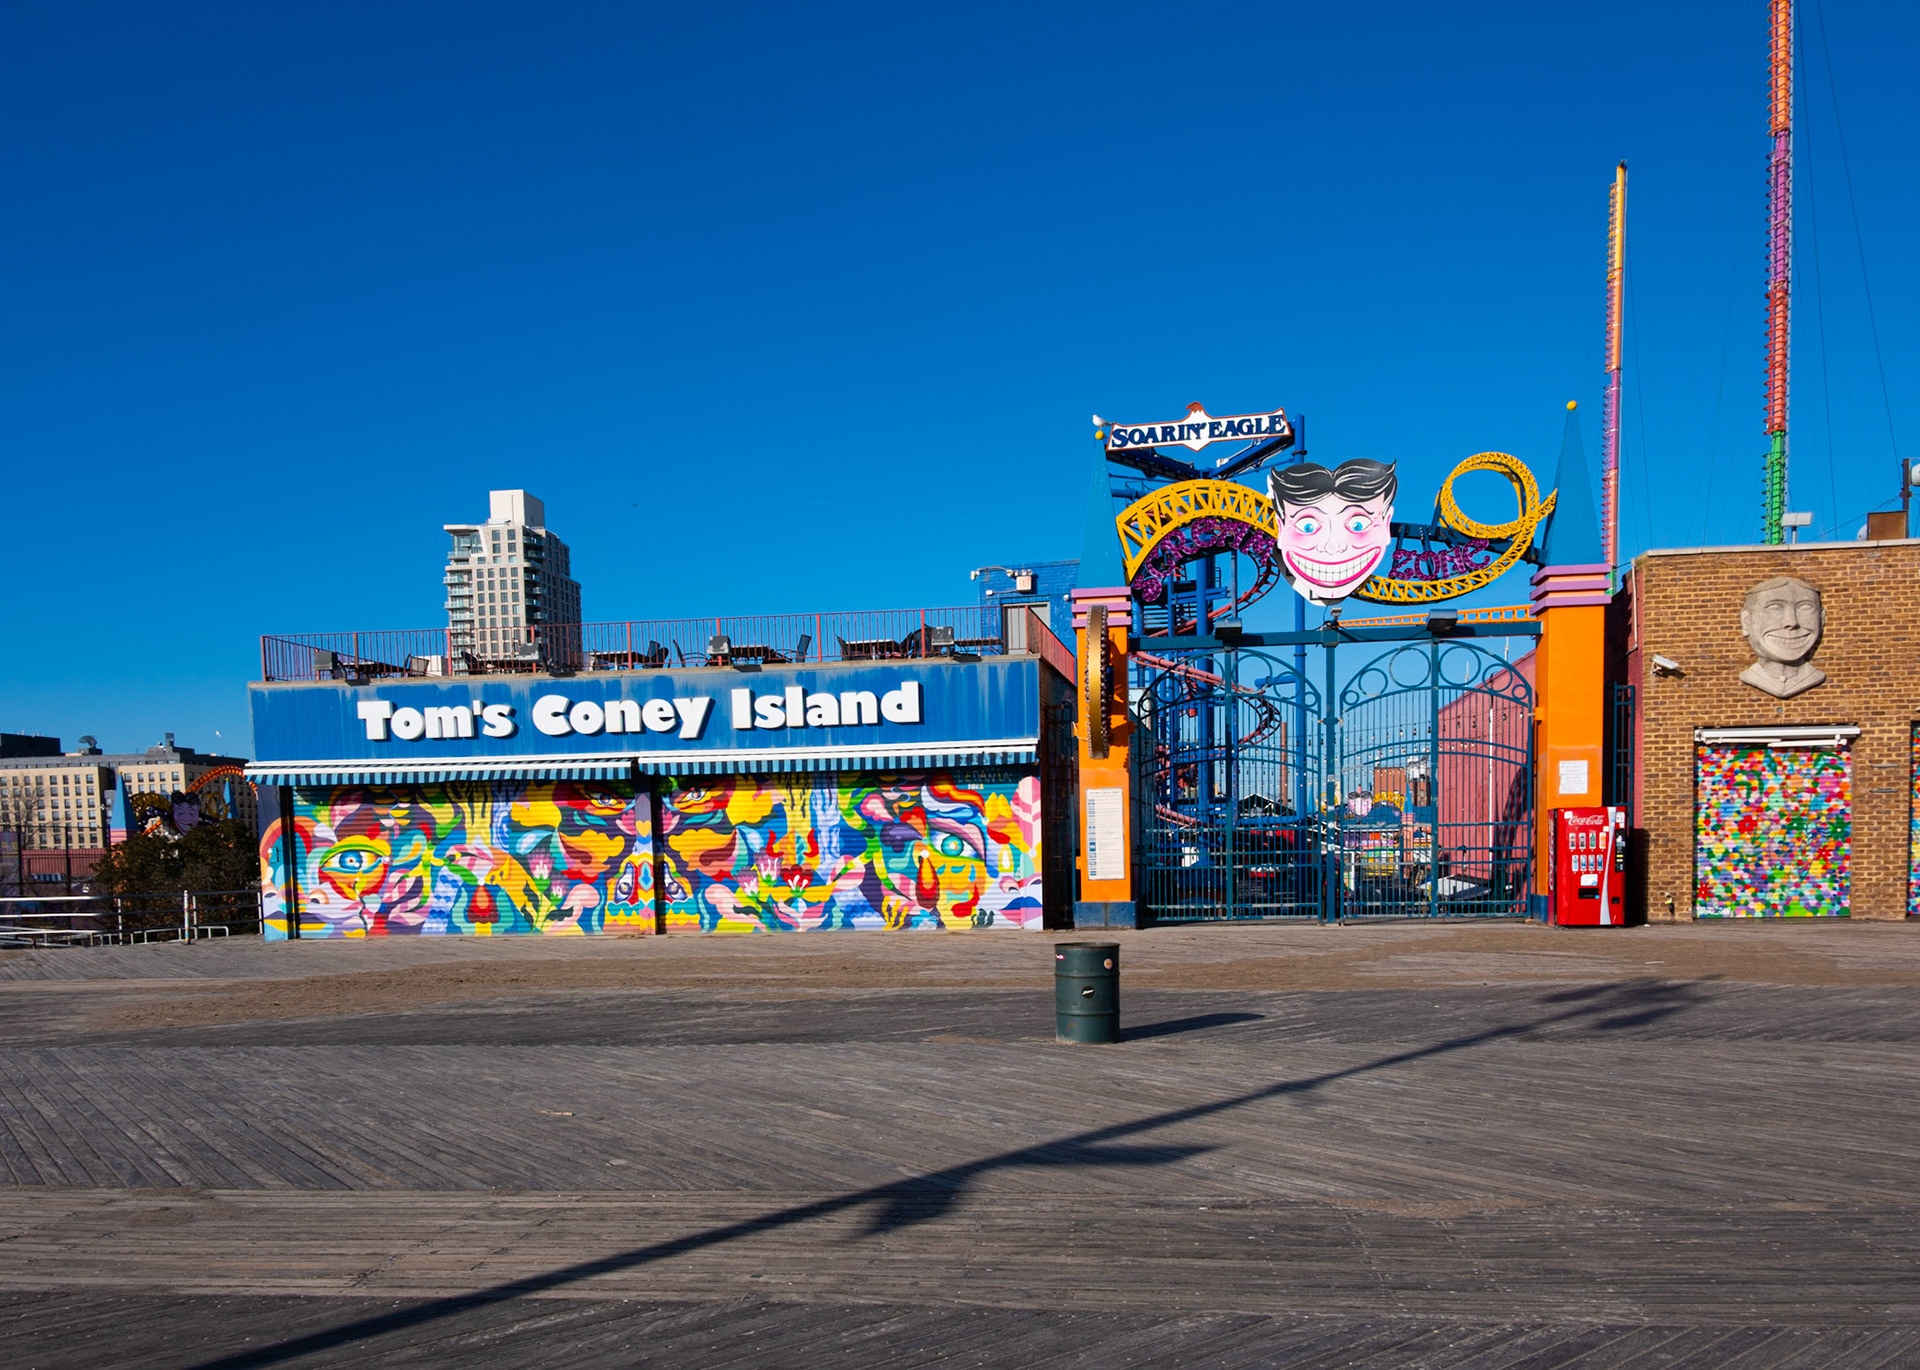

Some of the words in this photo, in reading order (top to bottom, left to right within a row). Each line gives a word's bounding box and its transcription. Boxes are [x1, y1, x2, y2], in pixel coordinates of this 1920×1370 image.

[1208, 414, 1286, 438] EAGLE
[1133, 517, 1278, 602] SCREAM
[1388, 538, 1491, 580] ZONE
[357, 699, 515, 740] Tom's
[532, 694, 711, 739] Coney
[731, 681, 920, 729] Island
